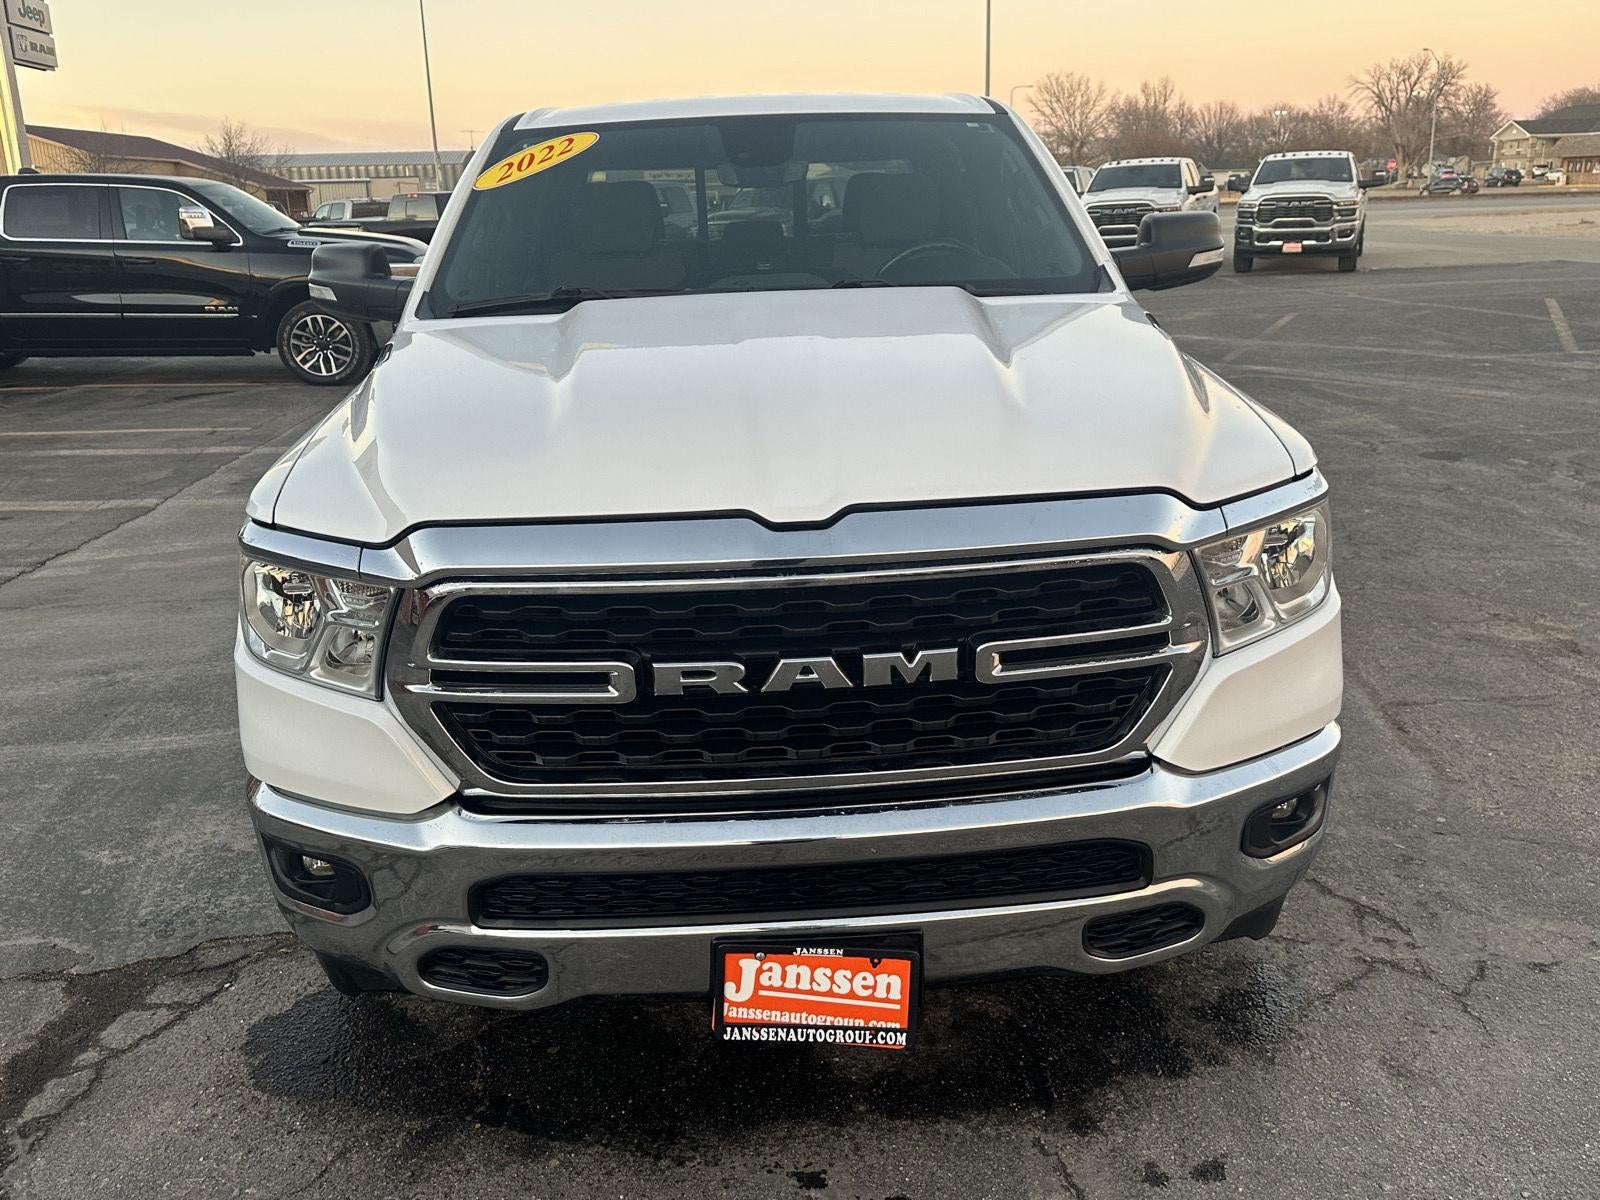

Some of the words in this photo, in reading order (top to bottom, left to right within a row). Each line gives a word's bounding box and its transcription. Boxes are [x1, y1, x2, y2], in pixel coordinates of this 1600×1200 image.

[18, 0, 45, 27] Jeep
[29, 41, 55, 56] RAM
[496, 137, 575, 183] 2022
[652, 648, 958, 696] RAM
[793, 947, 844, 956] JANSSEN
[724, 958, 902, 1002] Janssen
